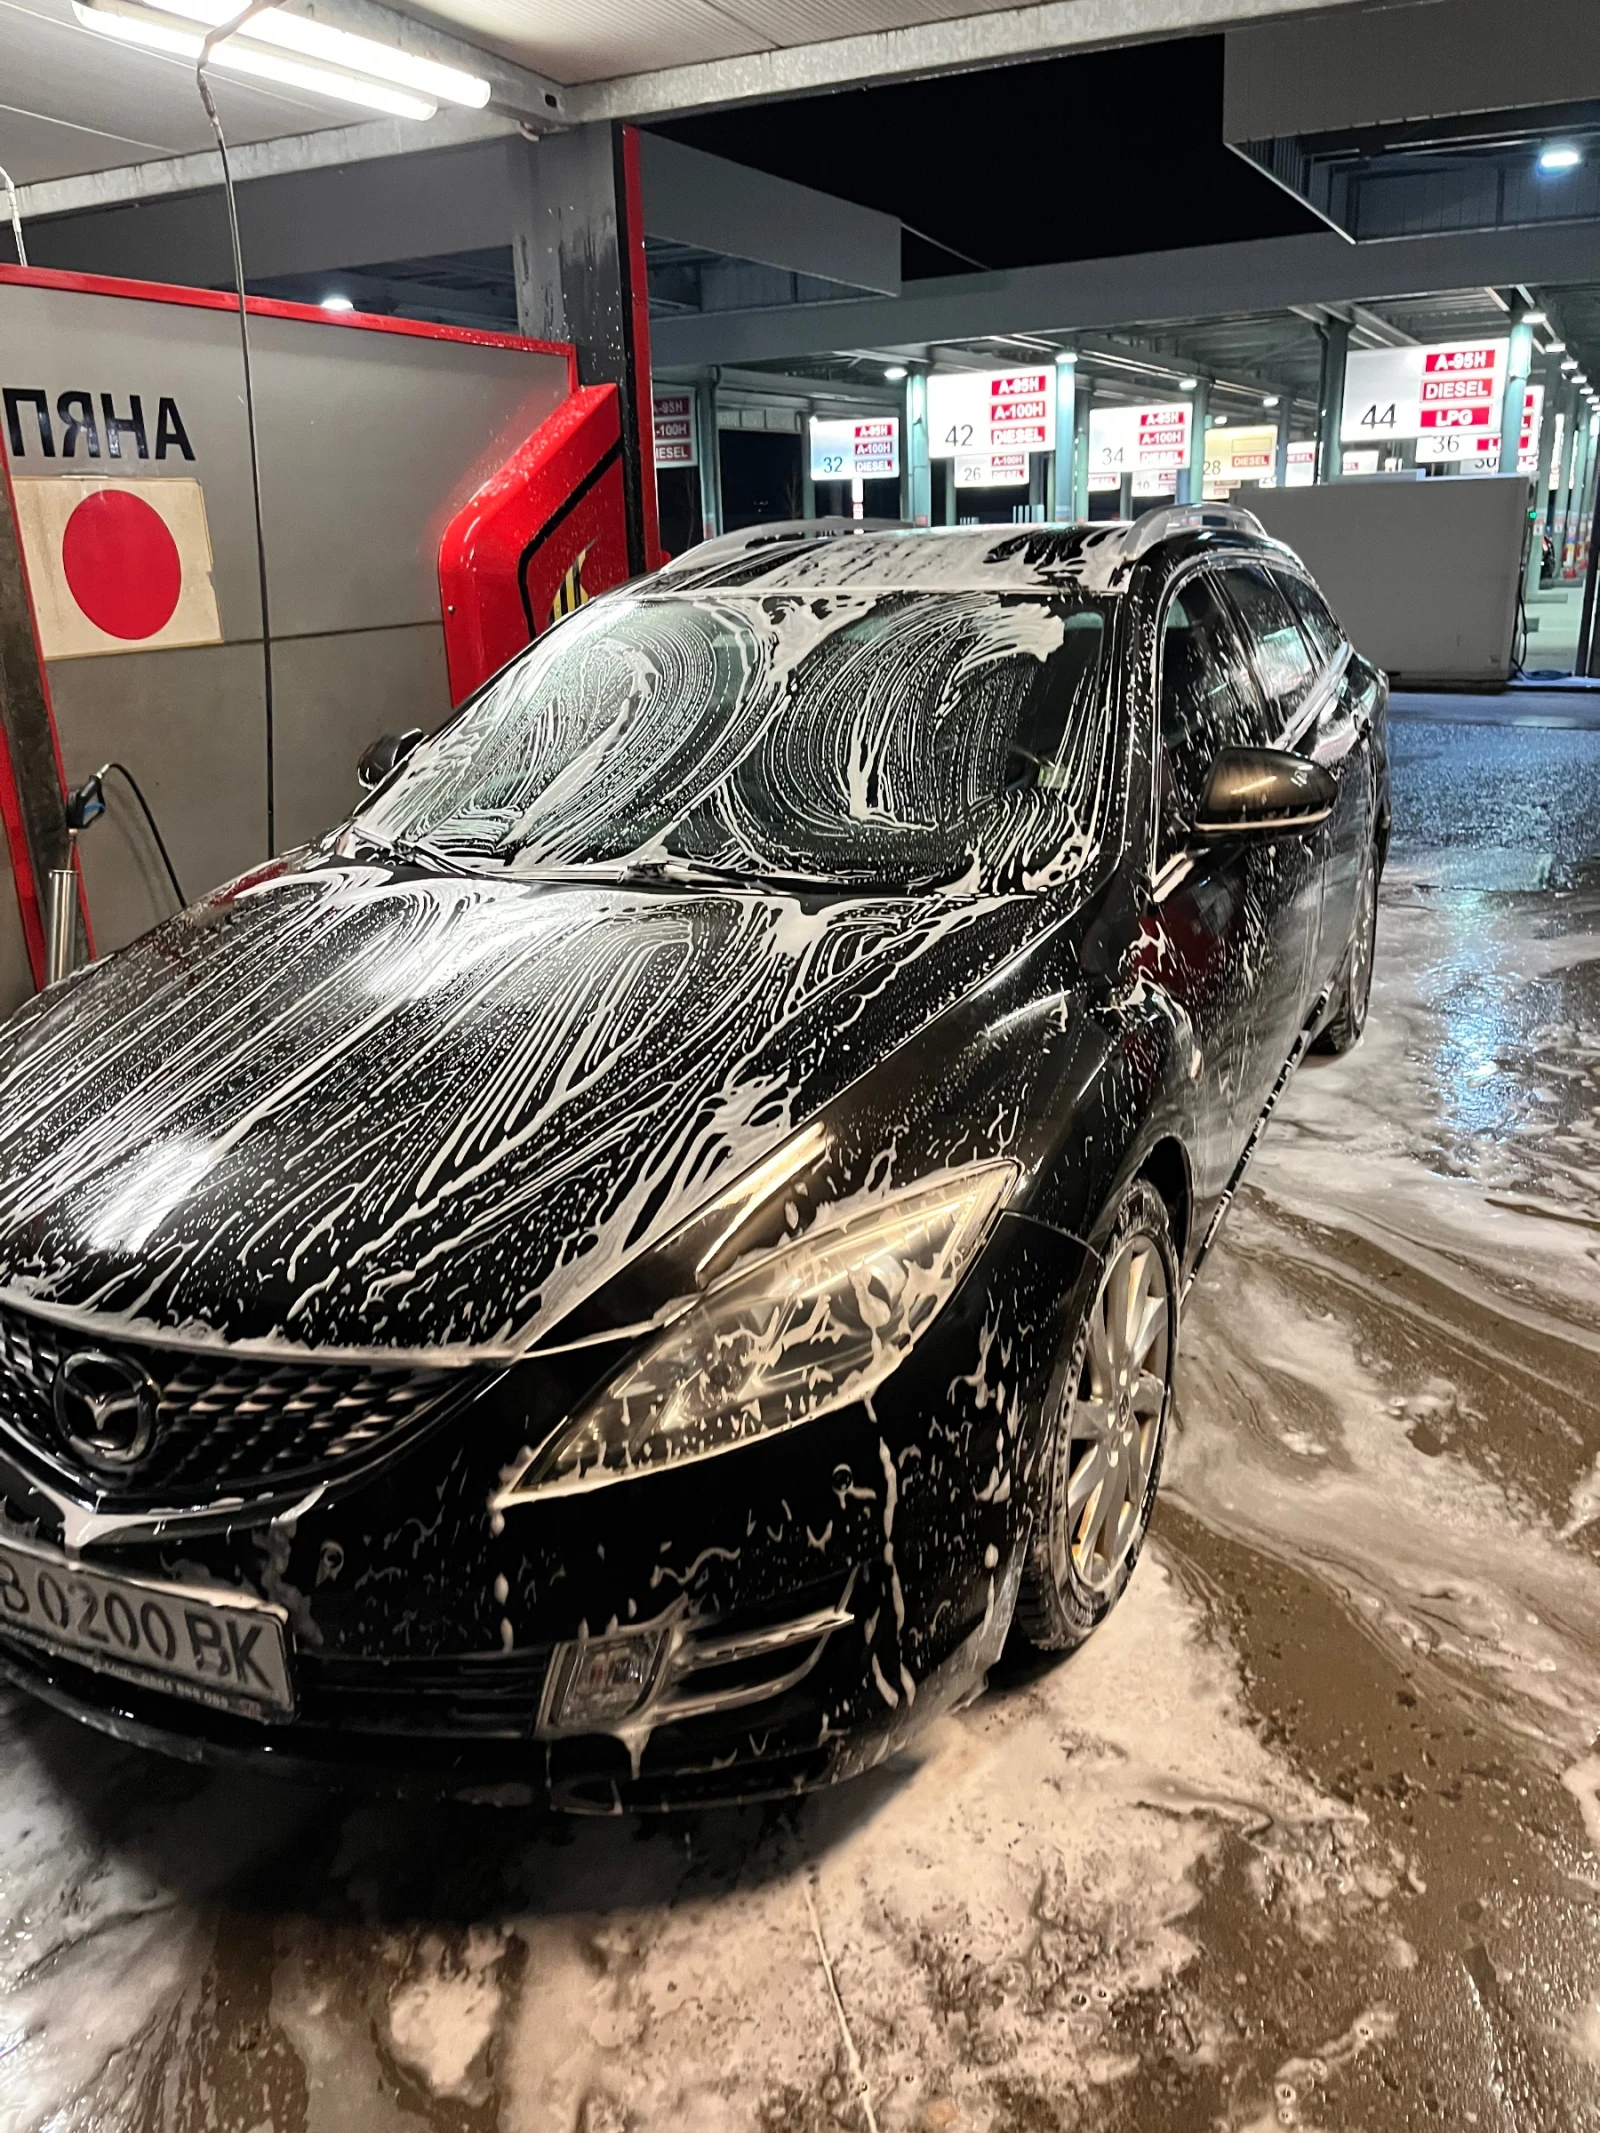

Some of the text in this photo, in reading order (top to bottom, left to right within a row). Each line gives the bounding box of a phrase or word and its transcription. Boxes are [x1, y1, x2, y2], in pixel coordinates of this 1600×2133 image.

[1434, 351, 1486, 371] A-95H
[998, 377, 1040, 395] A-95H
[1426, 381, 1489, 399] DIESEL
[993, 401, 1044, 420] A-100H
[1145, 411, 1179, 426] A-95H
[1361, 403, 1397, 430] 44
[1435, 409, 1473, 427] LPG
[2, 388, 197, 461] ПЯНА
[859, 424, 888, 437] A-95H
[944, 424, 974, 447] 42
[993, 427, 1044, 444] DIESEL
[1141, 430, 1182, 445] A-100H
[1432, 435, 1460, 454] 36
[856, 441, 891, 455] A-100H
[1102, 446, 1124, 466] 34
[823, 456, 843, 474] 32
[856, 460, 891, 473] DIESEL
[992, 454, 1023, 466] A-100H
[1203, 459, 1221, 475] 28
[1233, 455, 1267, 467] DIESEL
[963, 466, 982, 481] 26
[1136, 480, 1150, 490] 10
[37, 1571, 177, 1662] 0200
[184, 1606, 273, 1692] BK
